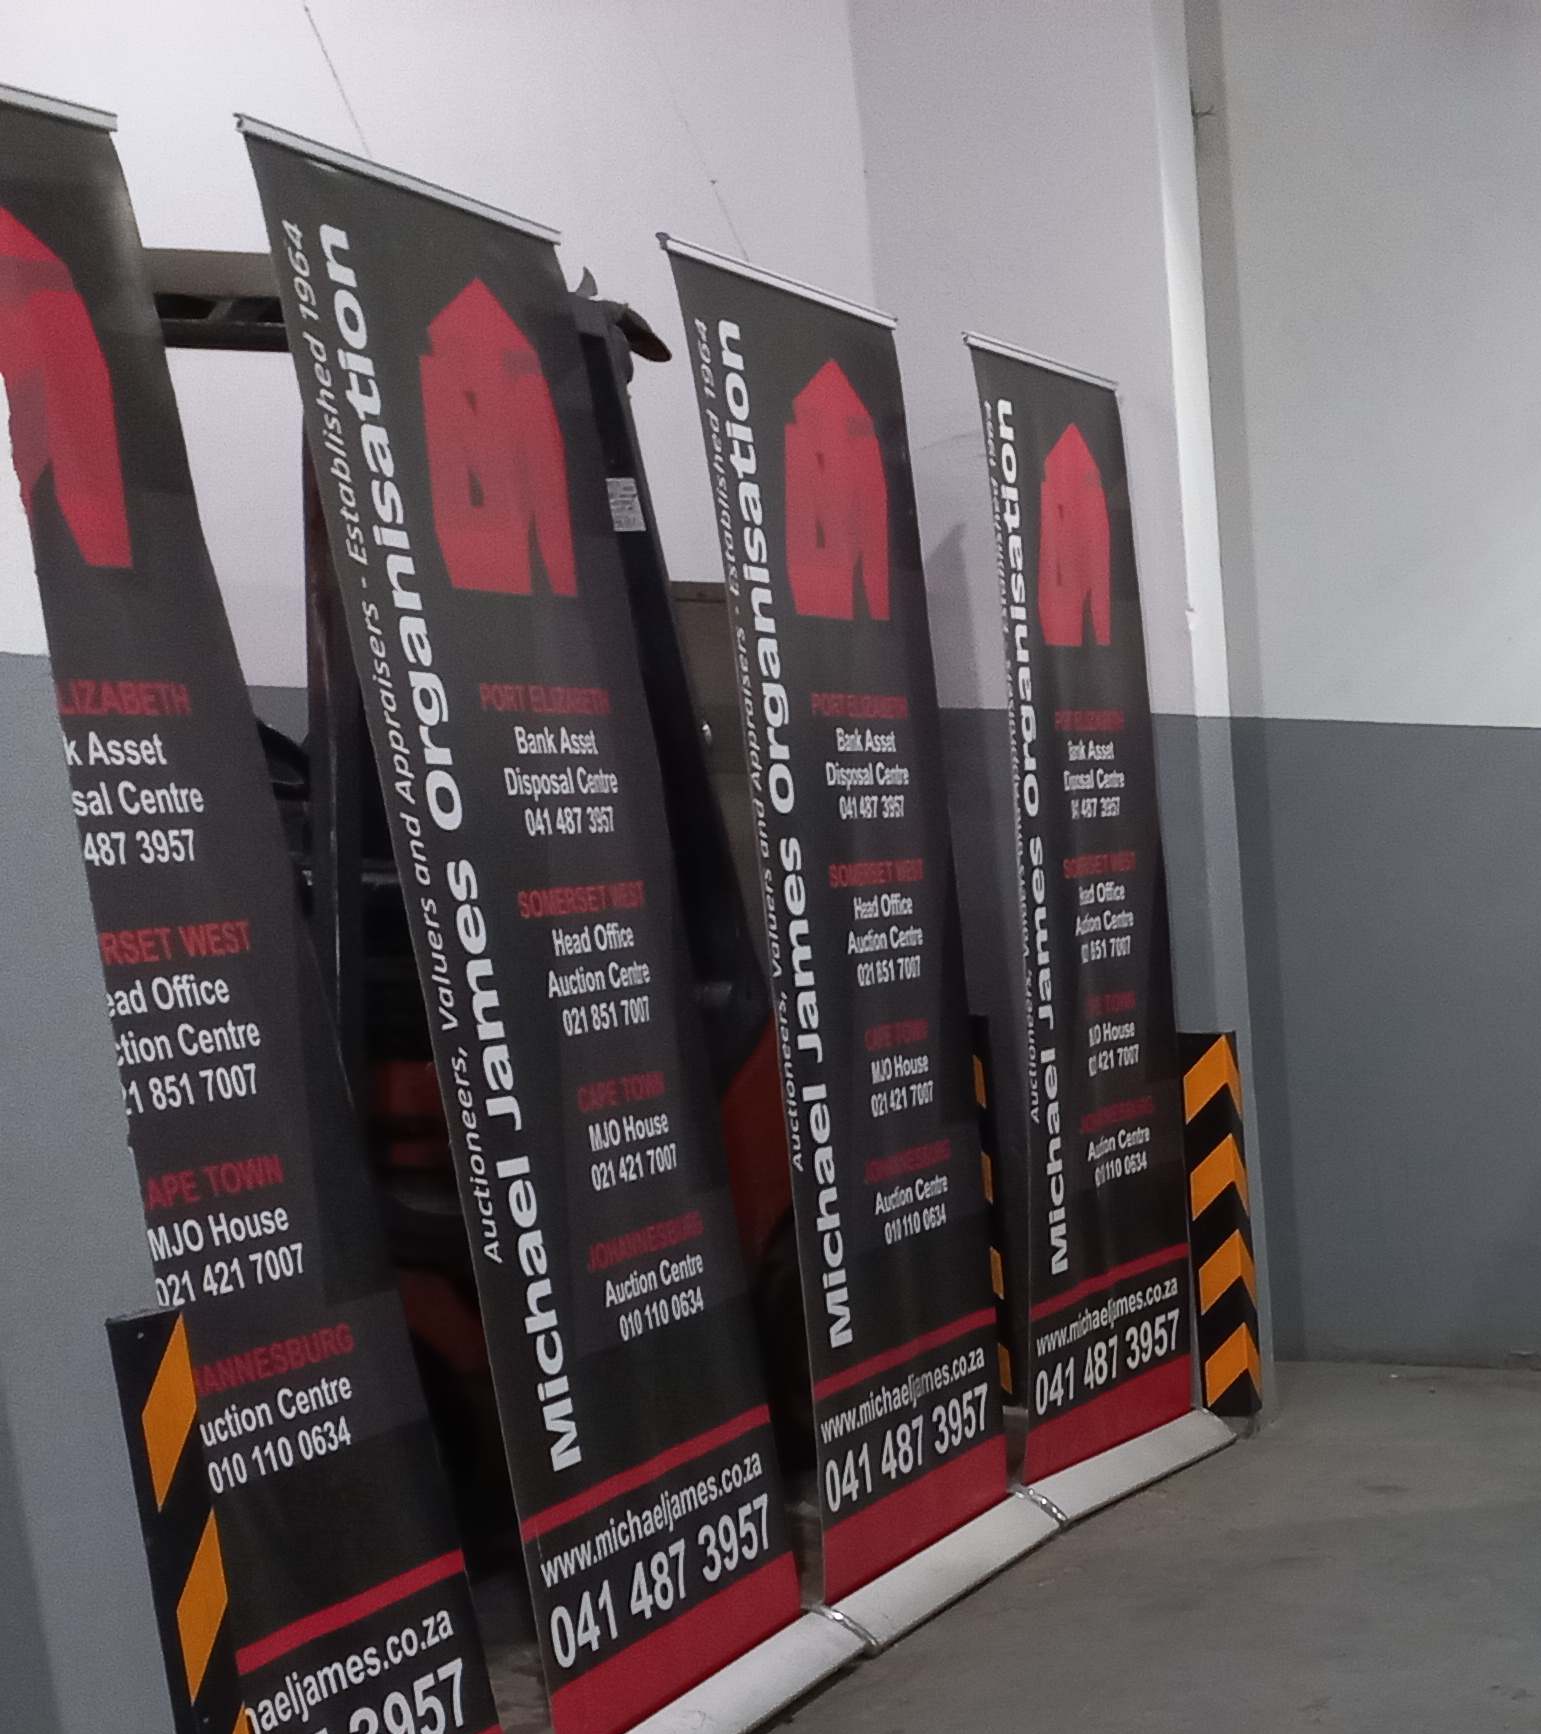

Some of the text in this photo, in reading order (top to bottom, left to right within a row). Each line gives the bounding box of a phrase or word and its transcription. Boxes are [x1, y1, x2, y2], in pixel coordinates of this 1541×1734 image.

[998, 399, 1039, 817] Organisation
[737, 627, 765, 792] Appraisers
[88, 731, 167, 766] Asset
[281, 219, 502, 1264] Auctioneers, Valuers and Appraisers Established 1964
[514, 726, 599, 755] Bank Asset
[117, 780, 205, 815] Centre
[504, 765, 619, 801] Disposal Centre
[84, 828, 195, 866] 487 3957
[319, 223, 582, 1473] Michael James Organisation
[524, 805, 614, 837] 041 487 3957
[718, 320, 853, 1349] Michael James Organisation
[753, 798, 770, 858] and
[178, 919, 250, 957] WEST
[552, 921, 635, 957] Head Office
[764, 868, 783, 978] Valuers
[1029, 836, 1054, 1030] James
[151, 973, 230, 1010] Office
[548, 960, 651, 999] Auction Centre
[177, 1019, 261, 1056] Centre
[562, 995, 650, 1037] 021 851 7007
[148, 1072, 195, 1111] 851
[199, 1062, 257, 1102] 7007
[588, 1113, 669, 1151] MJO House
[203, 1154, 284, 1197] TOWN
[591, 1143, 678, 1191] 021 421 7007
[1040, 1048, 1069, 1275] Michael
[147, 1207, 290, 1262] MJO House
[155, 1242, 304, 1307] 021 421 7007
[605, 1253, 704, 1307] Auction Centre
[619, 1286, 704, 1342] 010 110 0634
[1035, 1308, 1180, 1416] 041 487 3957
[277, 1376, 352, 1420] Centre
[820, 1347, 985, 1444] www.michaeljames.co.za
[208, 1415, 352, 1494] 010 110 0634
[825, 1382, 988, 1512] 041 487 3957
[540, 1452, 763, 1589] www.michaeljames.co.za
[550, 1493, 769, 1669] 041 487 3957
